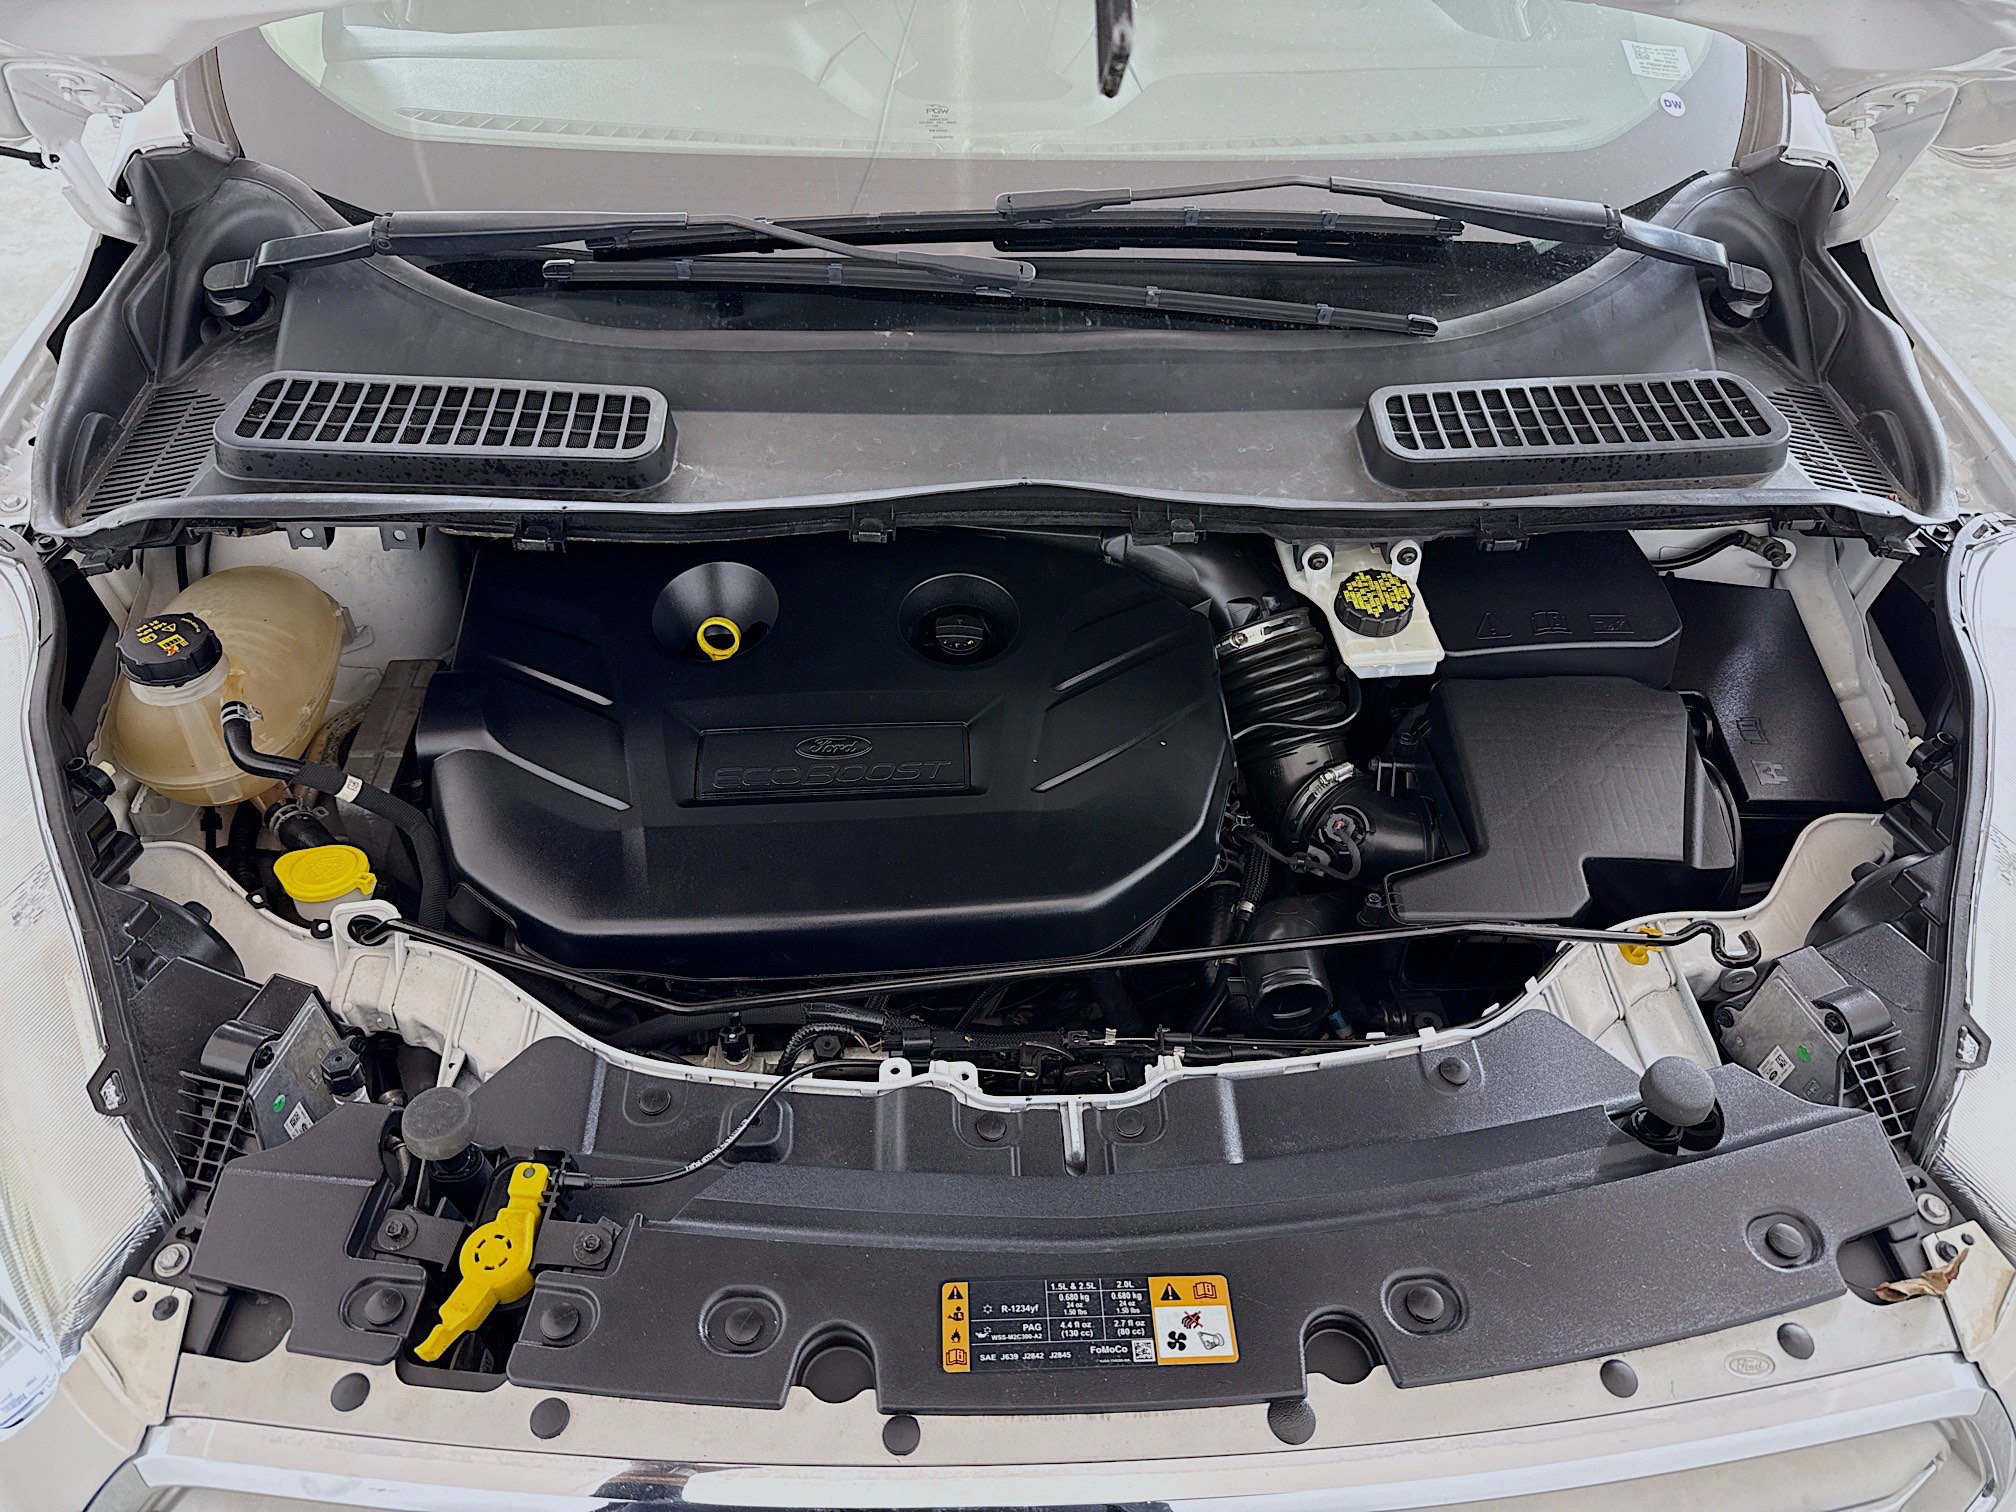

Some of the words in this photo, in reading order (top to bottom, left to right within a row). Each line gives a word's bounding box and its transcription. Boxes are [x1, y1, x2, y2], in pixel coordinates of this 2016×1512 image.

[1663, 99, 1682, 109] DW
[809, 737, 858, 754] Ford
[1050, 1282, 1068, 1290] 1.5L
[1070, 1282, 1077, 1290] &
[1078, 1282, 1097, 1290] 2.5L
[1116, 1280, 1135, 1288] 2.0L
[1058, 1293, 1079, 1302] 0.680
[1080, 1293, 1090, 1302] kg
[1110, 1292, 1131, 1300] 0.680
[1132, 1292, 1142, 1301] kg
[1001, 1304, 1039, 1314] R-1234yf
[1022, 1323, 1042, 1332] PAG
[1060, 1321, 1072, 1329] 4.4
[1074, 1320, 1080, 1328] fl
[1061, 1330, 1079, 1339] (130
[1080, 1330, 1094, 1338] cc)
[1117, 1328, 1130, 1337] (80
[1132, 1328, 1145, 1336] cc)
[1090, 1345, 1128, 1354] FoMoCo
[1049, 1351, 1072, 1359] J2845
